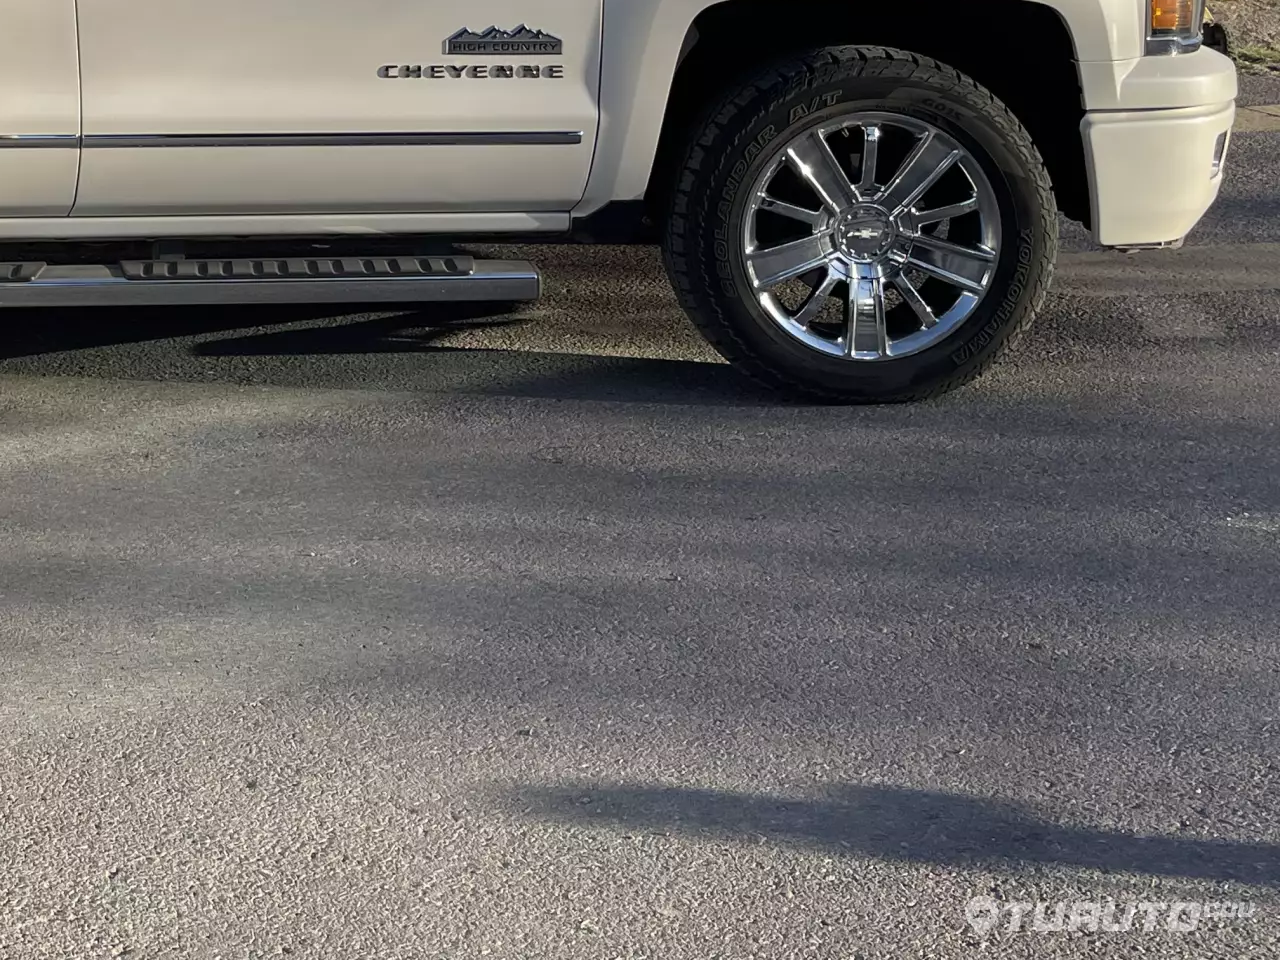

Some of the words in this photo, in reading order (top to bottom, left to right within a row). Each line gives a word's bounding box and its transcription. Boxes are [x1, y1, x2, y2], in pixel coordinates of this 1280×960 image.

[376, 64, 565, 79] CHEYENNE
[452, 42, 487, 52] HIGH
[492, 41, 559, 52] COUNTRY
[713, 123, 778, 300] GEOLANDAR
[788, 88, 843, 124] A/T
[949, 226, 1034, 367] YOKOHAMA
